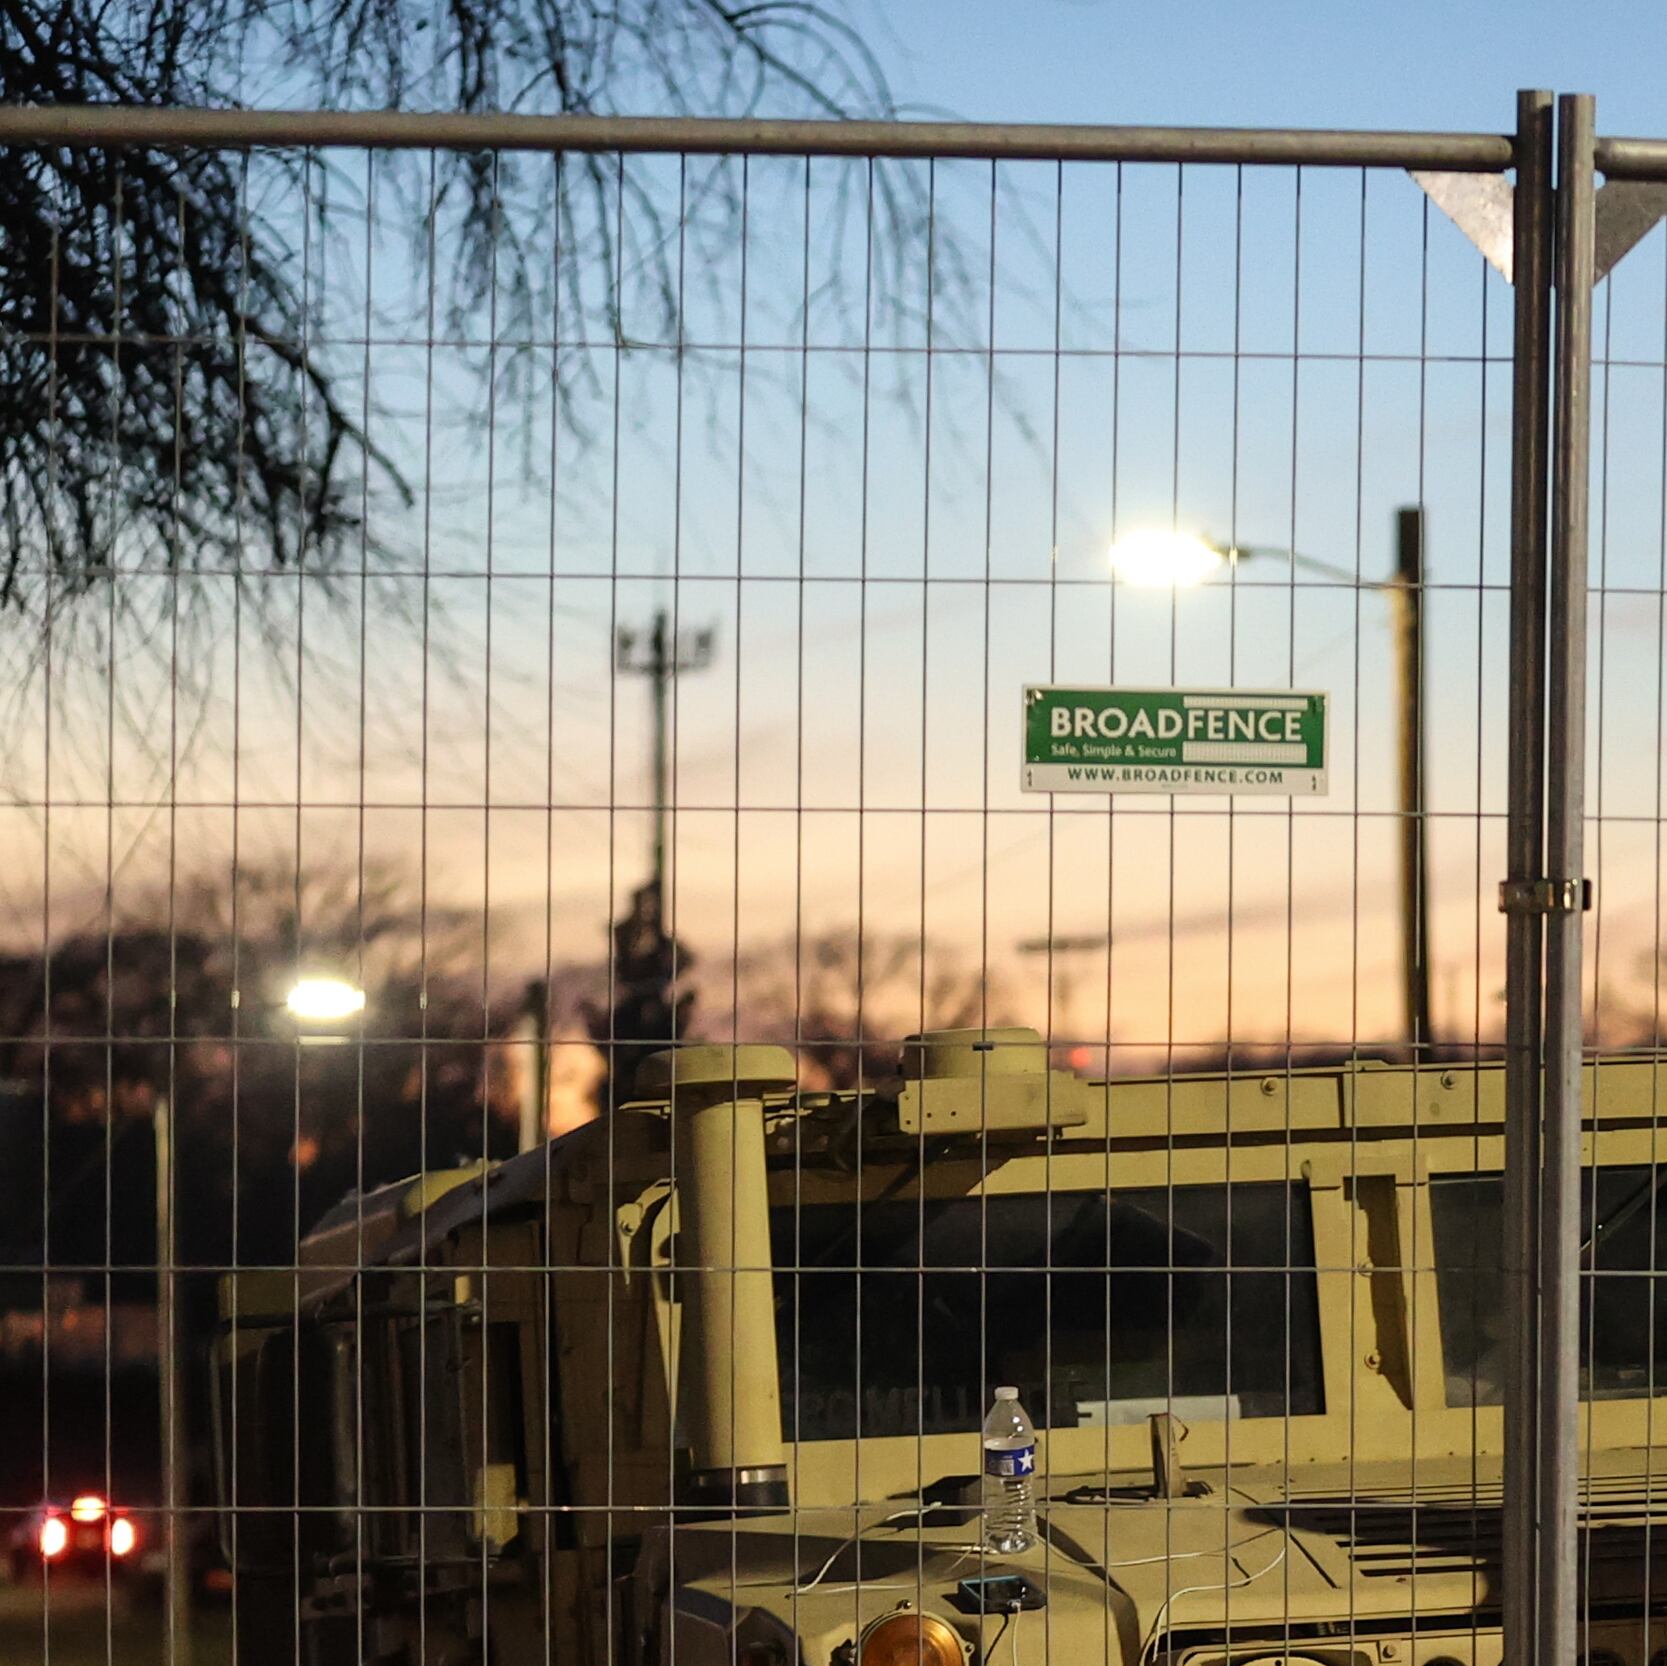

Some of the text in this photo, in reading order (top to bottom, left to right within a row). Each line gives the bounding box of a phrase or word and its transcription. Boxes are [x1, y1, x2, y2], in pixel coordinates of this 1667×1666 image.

[1050, 706, 1302, 741] BROADFENCE
[1082, 742, 1122, 760] Simple
[1124, 744, 1135, 757] &
[1138, 744, 1177, 759] Secure
[1067, 767, 1284, 784] WWW.BROADFENCE.COM
